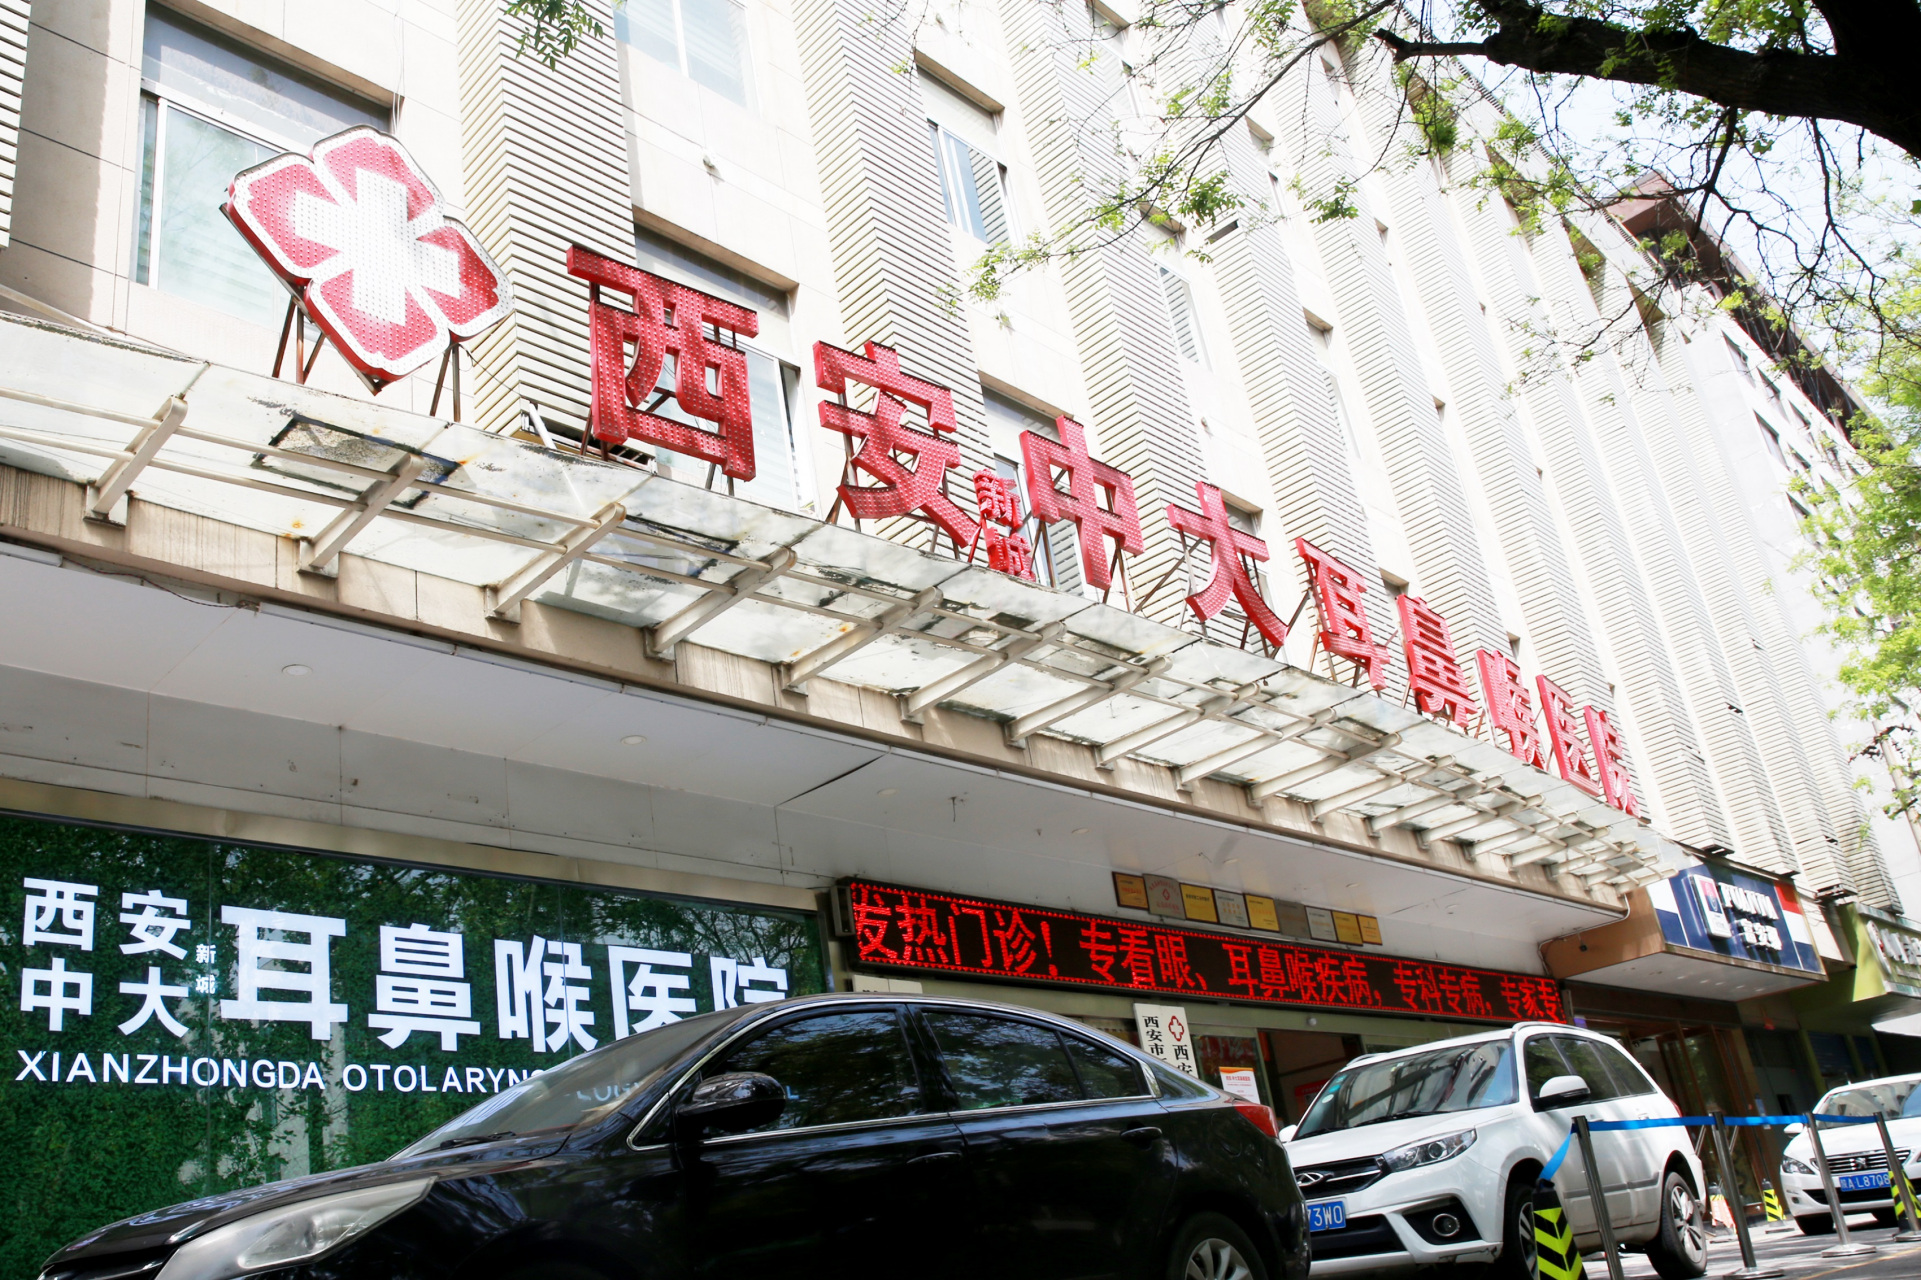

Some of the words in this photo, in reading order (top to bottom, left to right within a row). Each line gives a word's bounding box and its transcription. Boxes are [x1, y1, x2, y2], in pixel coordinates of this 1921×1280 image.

[23, 877, 191, 960] 西安
[20, 957, 190, 1038] 中大
[1142, 1015, 1167, 1061] 西安市
[15, 1050, 326, 1091] XIANZHONGDA
[342, 1064, 545, 1094] OTOLARYN
